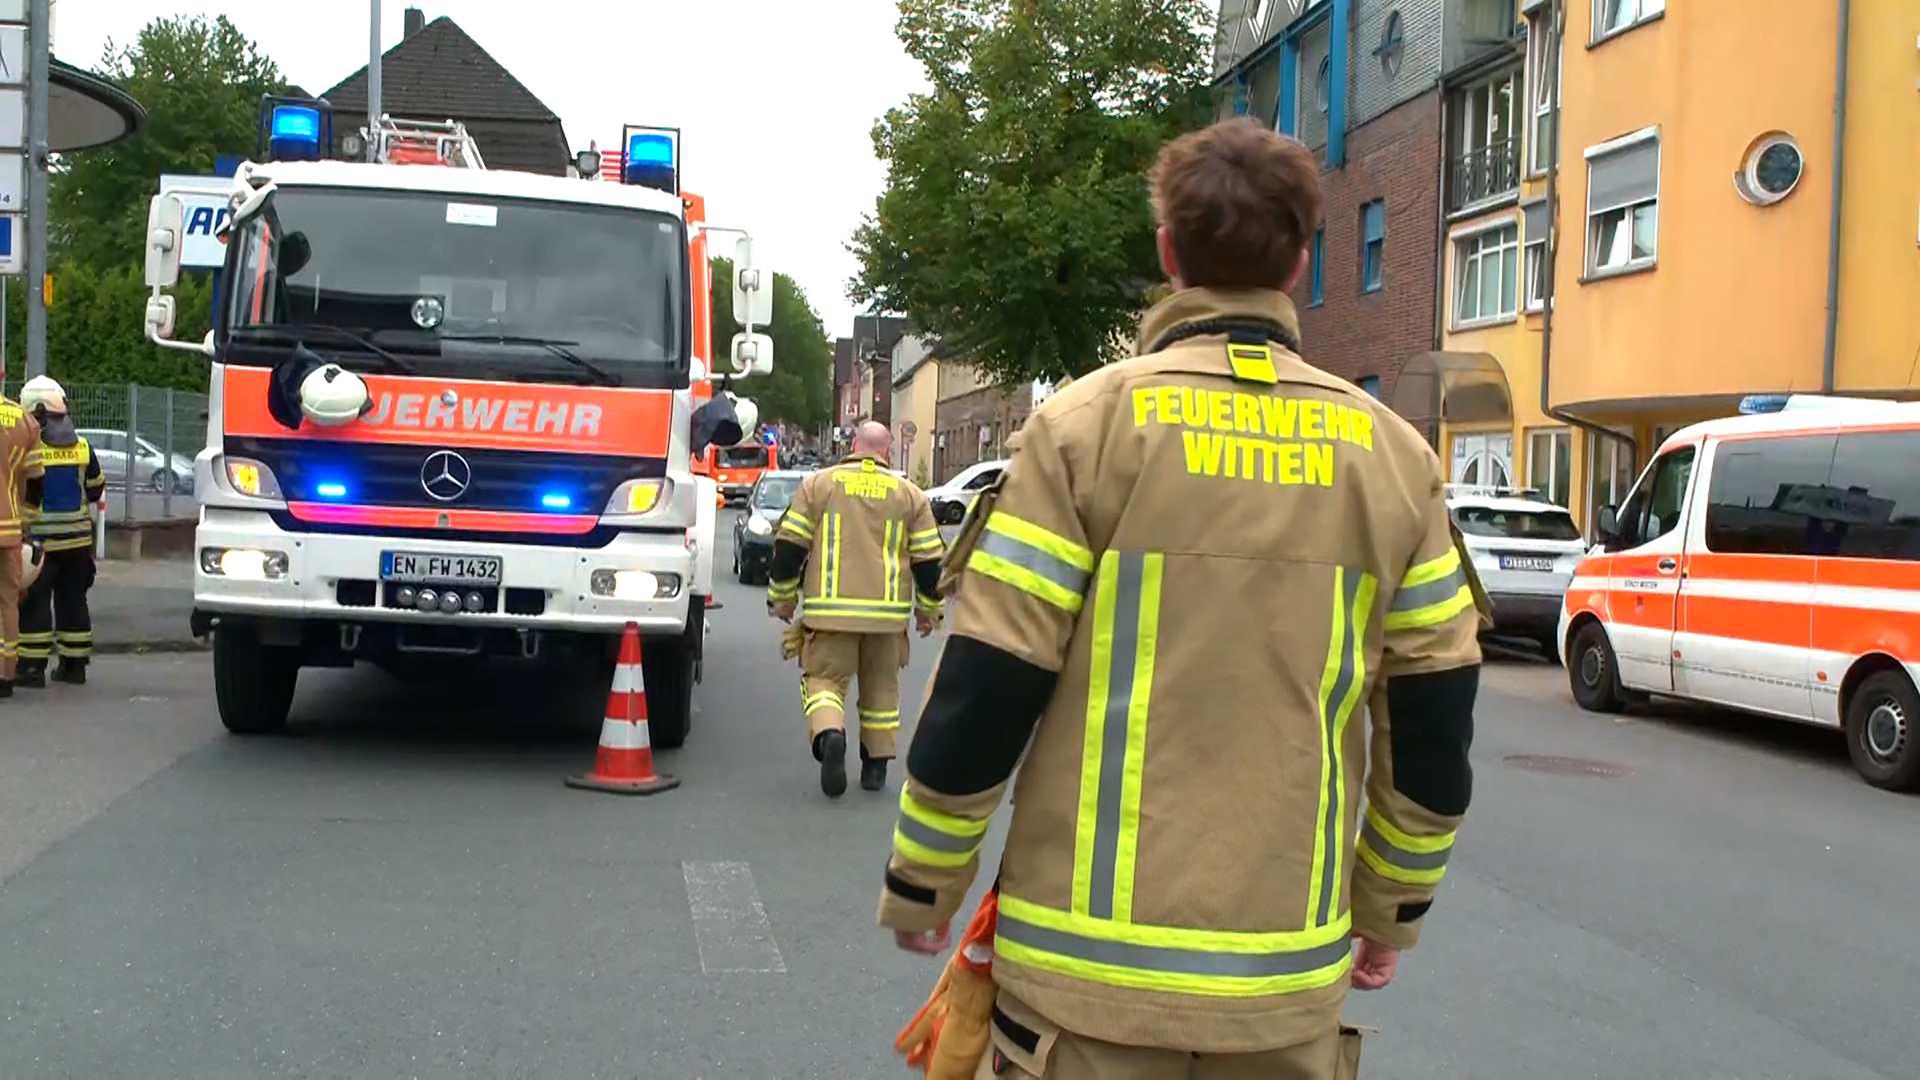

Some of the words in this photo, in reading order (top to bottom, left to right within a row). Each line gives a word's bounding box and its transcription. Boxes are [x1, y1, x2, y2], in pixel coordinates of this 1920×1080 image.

[361, 392, 602, 436] UERWEHR
[1132, 386, 1374, 451] FEUERWEHR
[1182, 431, 1335, 486] WITTEN
[394, 557, 416, 574] EN
[428, 559, 451, 576] FW
[455, 561, 498, 578] 1432
